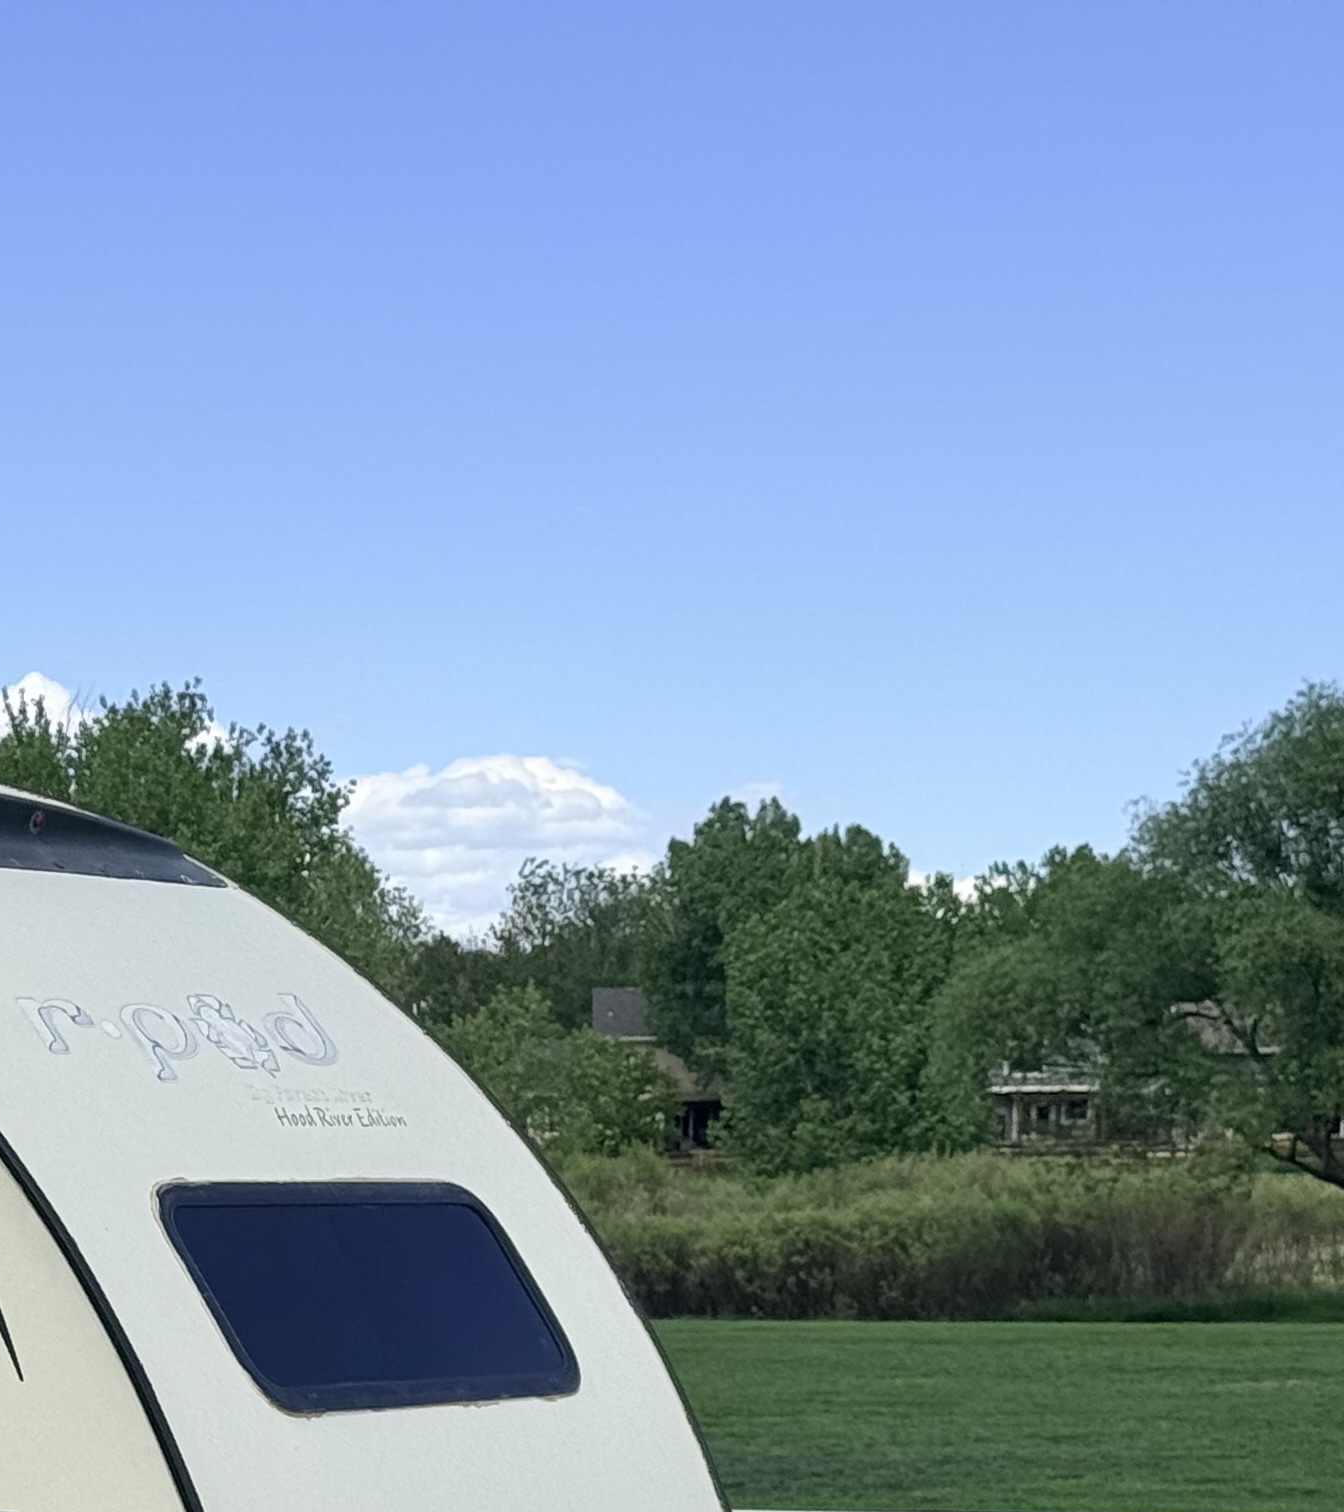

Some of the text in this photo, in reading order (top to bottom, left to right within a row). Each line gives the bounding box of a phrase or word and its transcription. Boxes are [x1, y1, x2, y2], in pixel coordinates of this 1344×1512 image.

[274, 1104, 408, 1128] Hood River Edition
